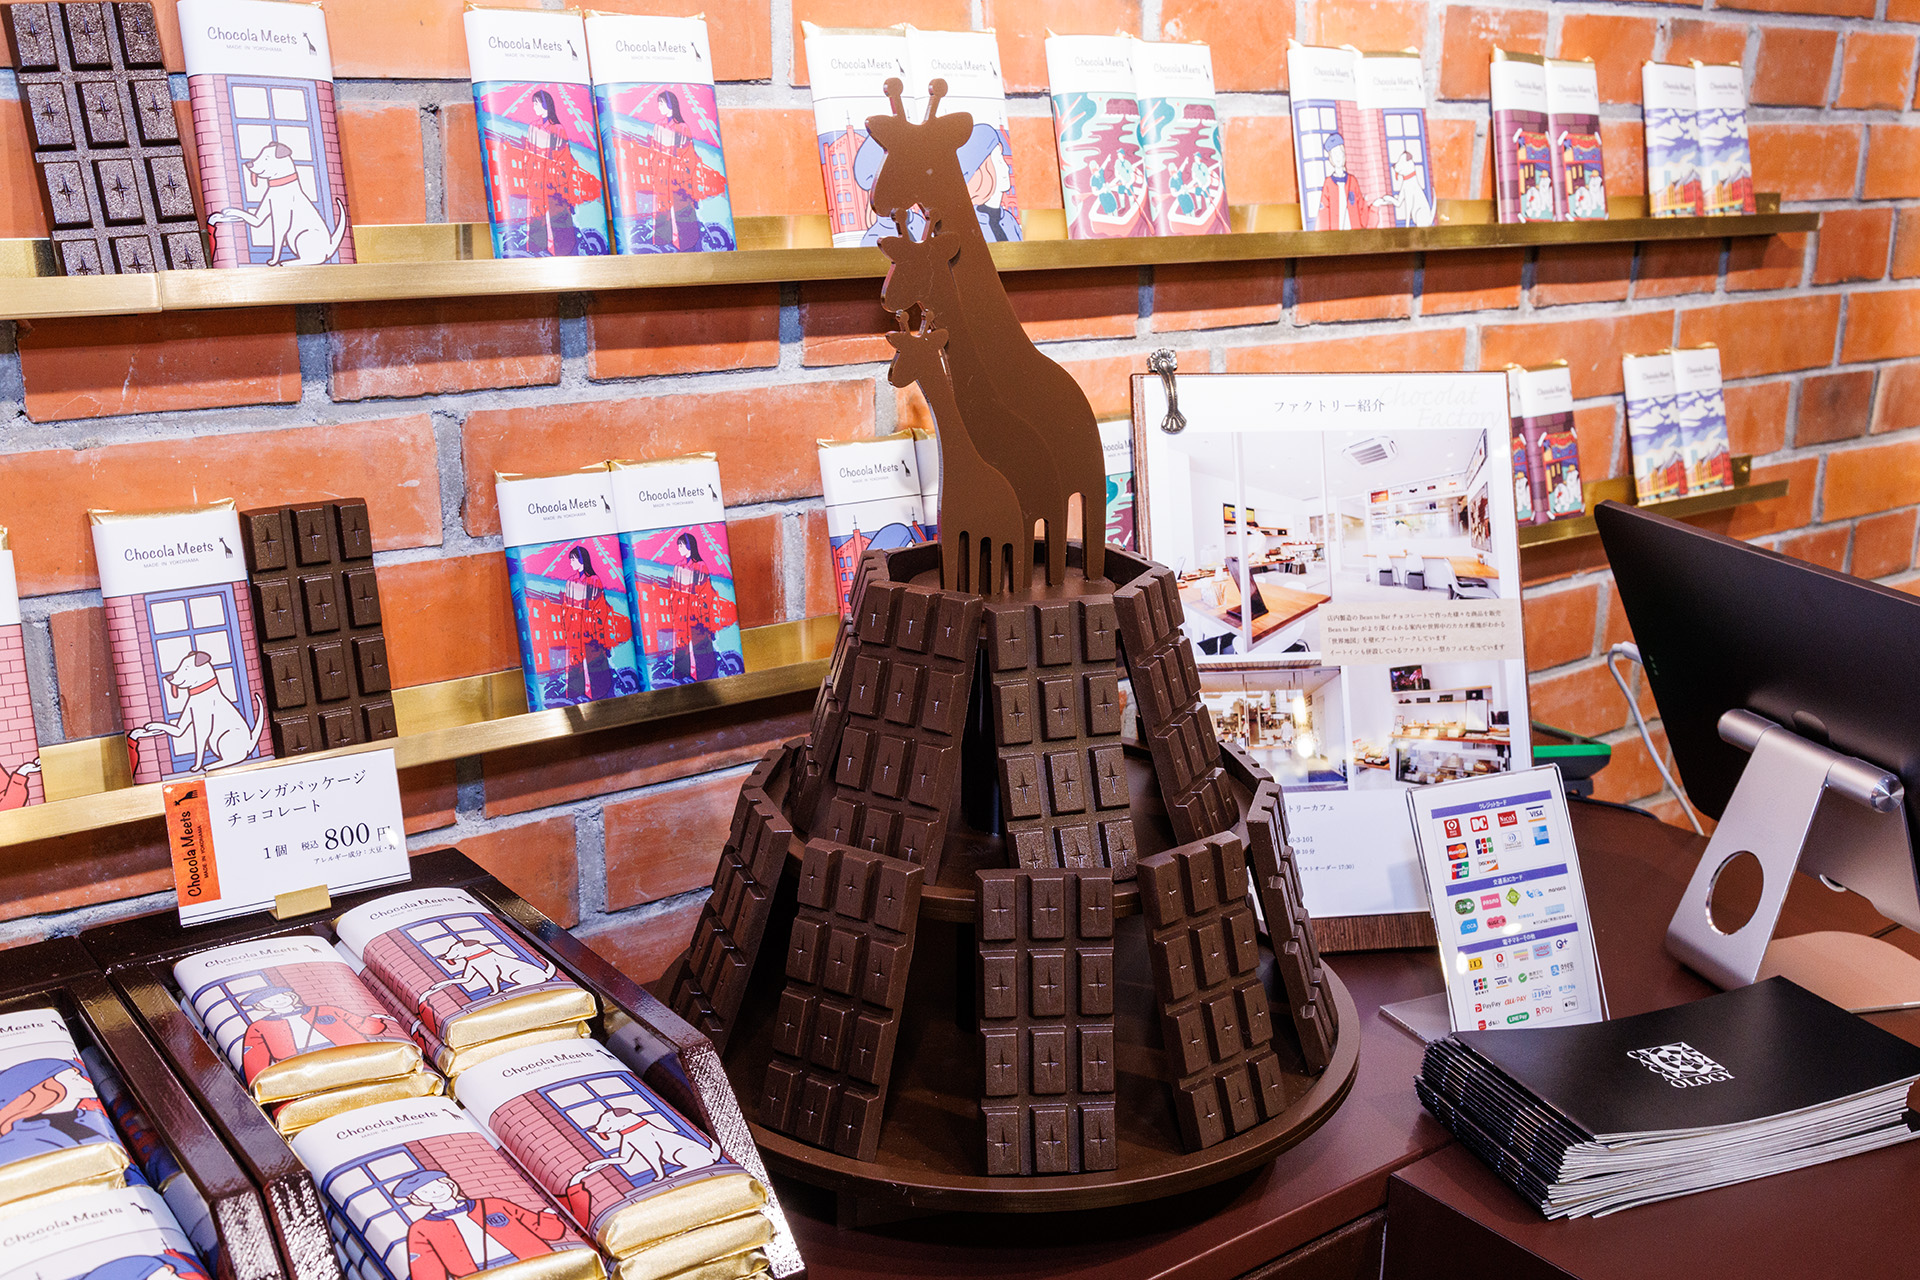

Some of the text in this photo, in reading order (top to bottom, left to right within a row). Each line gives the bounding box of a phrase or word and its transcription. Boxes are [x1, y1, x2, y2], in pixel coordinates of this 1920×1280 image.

[207, 26, 298, 45] Chocola Meets
[488, 35, 562, 52] Chocola Meets
[615, 39, 687, 53] Chocola Meets
[831, 58, 893, 70] Chocola Meets
[931, 59, 986, 72] Chocola Meets
[1274, 397, 1385, 413] ファクトリー紹介
[1103, 440, 1124, 452] hocola
[839, 463, 899, 478] Chocola Meets
[638, 486, 705, 502] Chocola Meets
[527, 498, 597, 515] Chocola Meets
[124, 542, 214, 561] Chocola Meets
[224, 769, 366, 808] 赤レンガパッケージ
[228, 799, 321, 828] チョコレート
[1289, 804, 1335, 813] トリーカフェ
[1529, 809, 1544, 818] VISA
[1471, 816, 1487, 831] DC
[301, 840, 319, 851] 税込
[324, 822, 370, 851] 800
[180, 810, 202, 897] Chocola Meets
[1476, 840, 1494, 852] JCB
[201, 855, 207, 863] IN
[201, 863, 209, 879] MADE
[369, 900, 418, 921] Chocola
[417, 895, 455, 906] Meets
[204, 951, 258, 969] Chocola
[259, 946, 300, 956] Meets
[501, 1051, 594, 1078] Chocola Meets
[336, 1110, 438, 1141] Chocola Meets
[3, 1220, 70, 1248] Chocola
[72, 1207, 124, 1223] Meets
